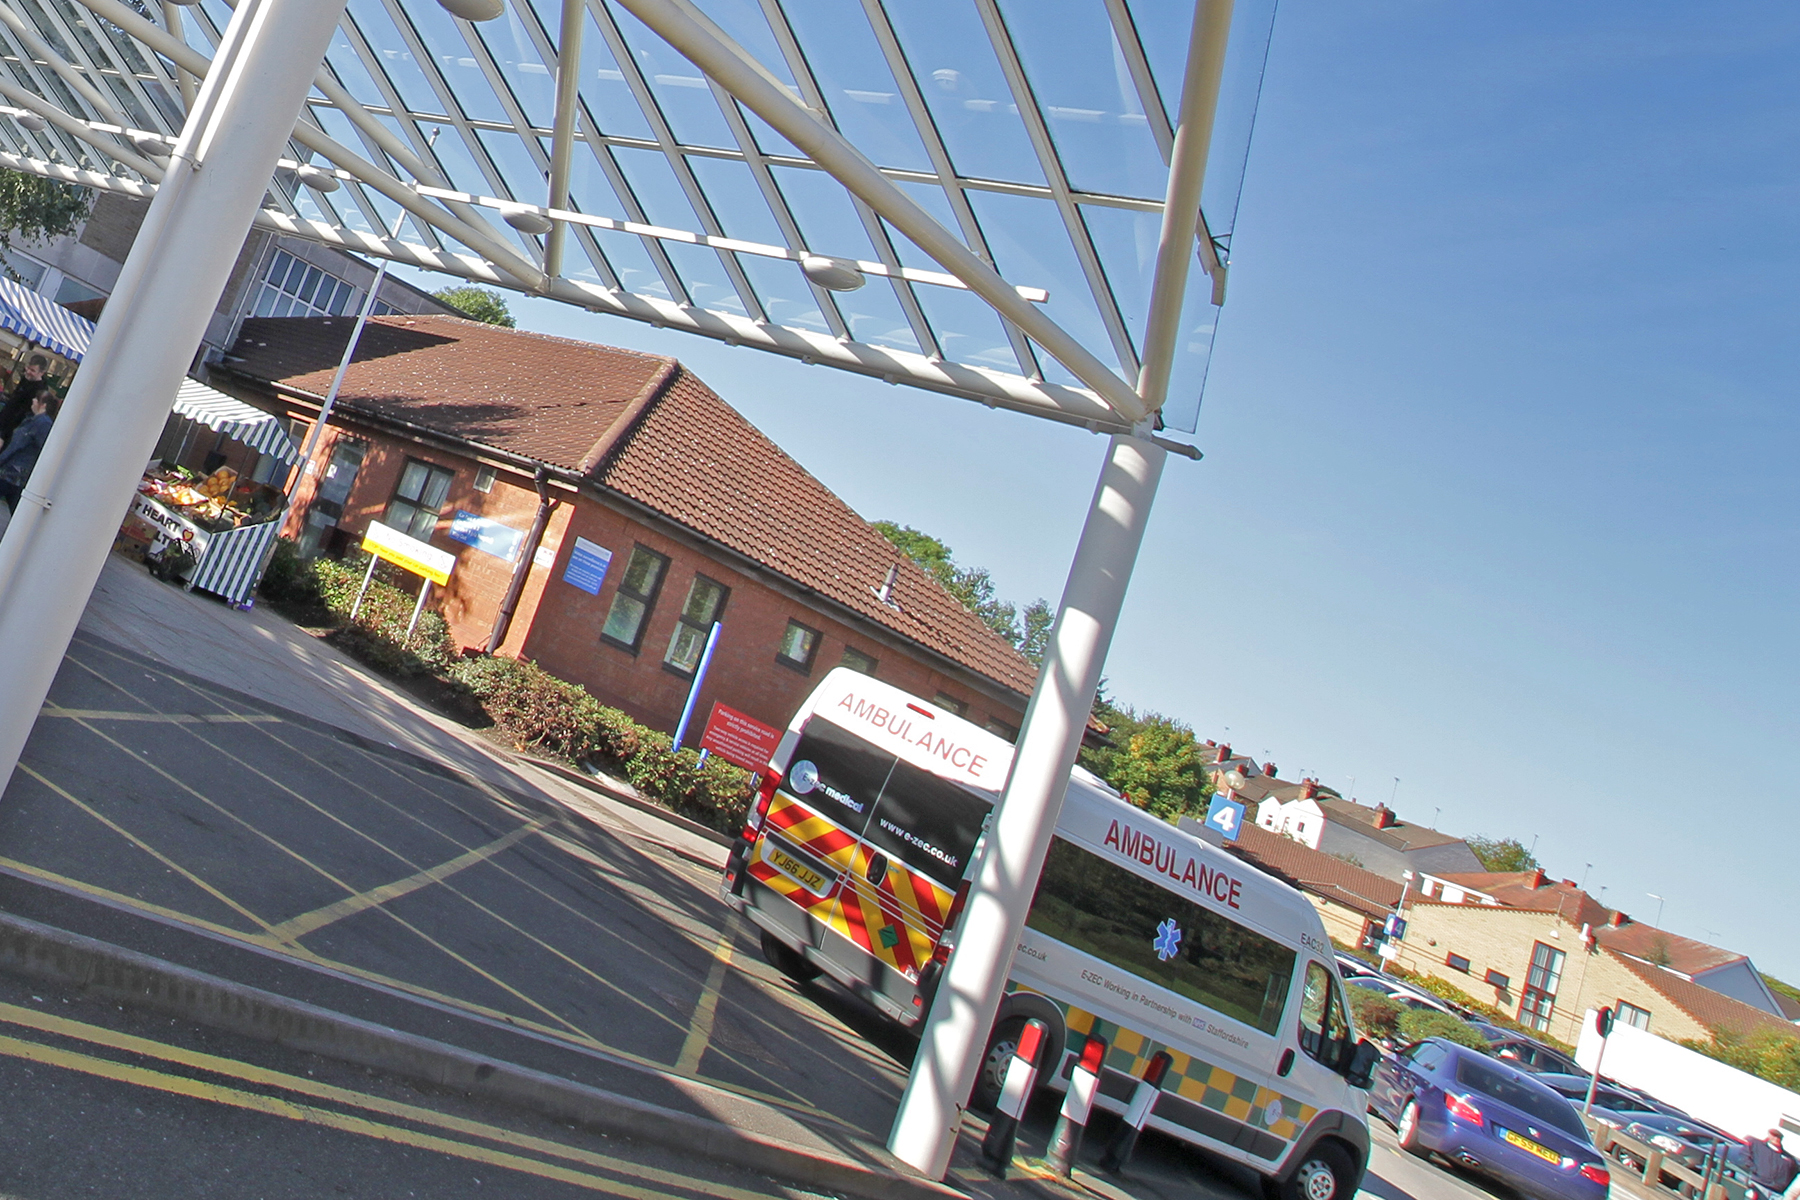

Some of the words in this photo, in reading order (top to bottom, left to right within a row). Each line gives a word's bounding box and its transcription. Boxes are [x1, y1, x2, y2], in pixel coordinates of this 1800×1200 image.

[142, 504, 181, 533] HEART
[717, 709, 734, 720] Parking
[747, 723, 761, 732] service
[761, 729, 771, 737] road
[726, 721, 740, 731] strictly
[838, 693, 988, 777] AMBULANCE
[802, 772, 827, 793] E-zec
[825, 786, 864, 814] medical
[1212, 806, 1237, 832] 4
[880, 818, 959, 867] wwwe-zec.co.uk
[773, 851, 800, 874] YJ66
[798, 870, 821, 888] JJZ
[1104, 819, 1242, 910] AMBULANCE
[1017, 942, 1048, 962] ec.co.uk
[1300, 932, 1325, 956] EAC32
[1080, 969, 1102, 987] E-ZEC
[1103, 979, 1131, 1001] Working
[1139, 994, 1178, 1020] Partnership
[1177, 1011, 1193, 1025] with
[1193, 1017, 1206, 1031] NHS
[1206, 1024, 1250, 1049] Staffordshire
